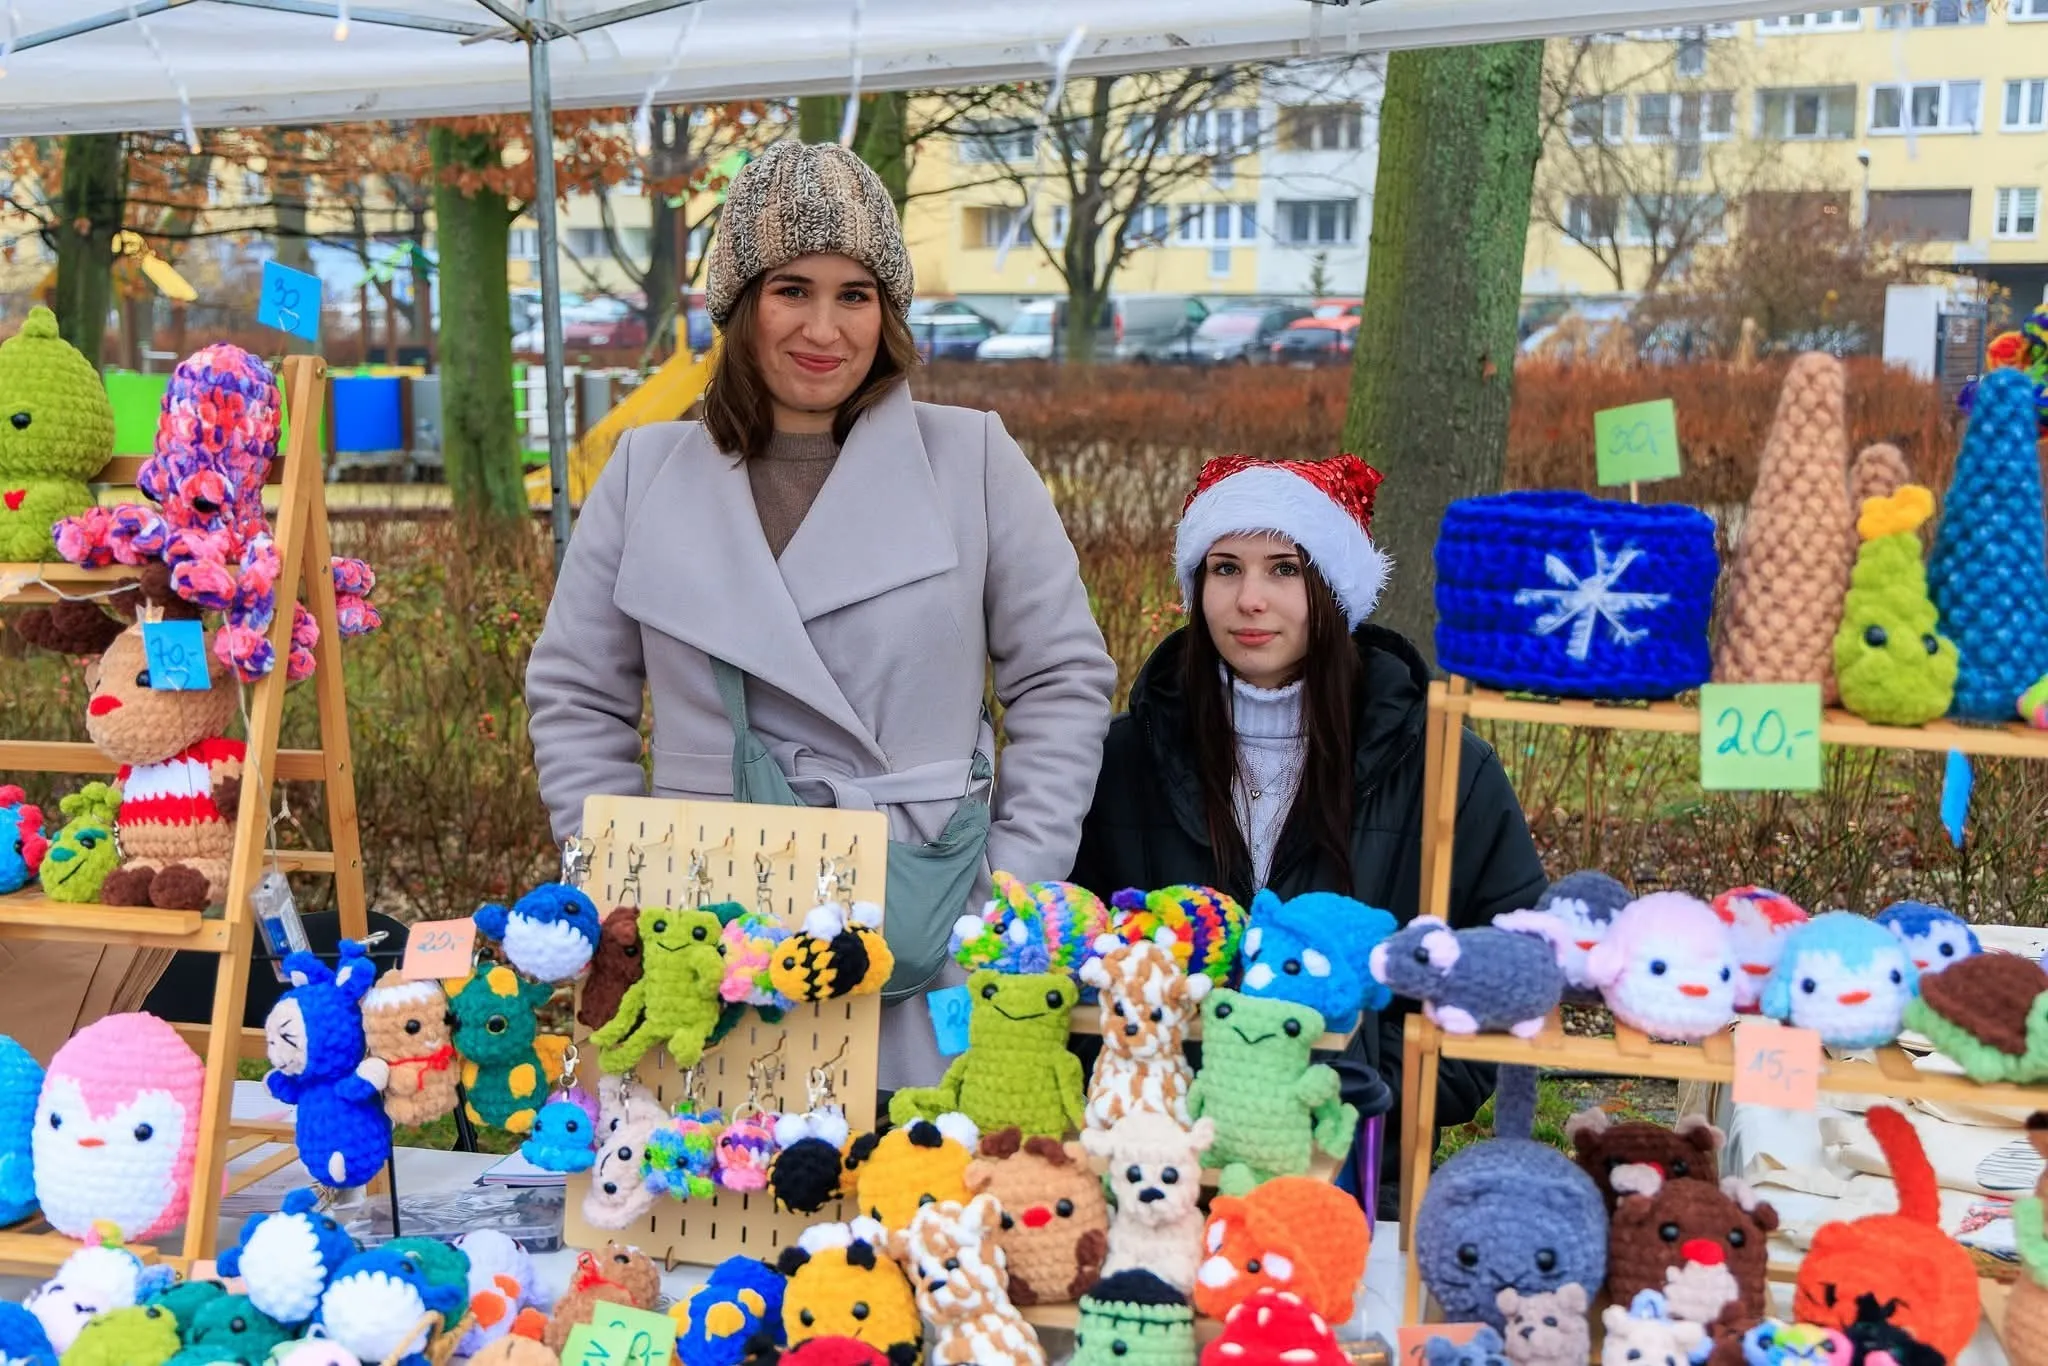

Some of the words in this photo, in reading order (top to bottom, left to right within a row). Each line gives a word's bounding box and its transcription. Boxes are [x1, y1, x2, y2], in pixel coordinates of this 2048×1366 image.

[272, 277, 300, 310] 30
[150, 637, 198, 668] 70,-
[1716, 706, 1815, 761] 20,-
